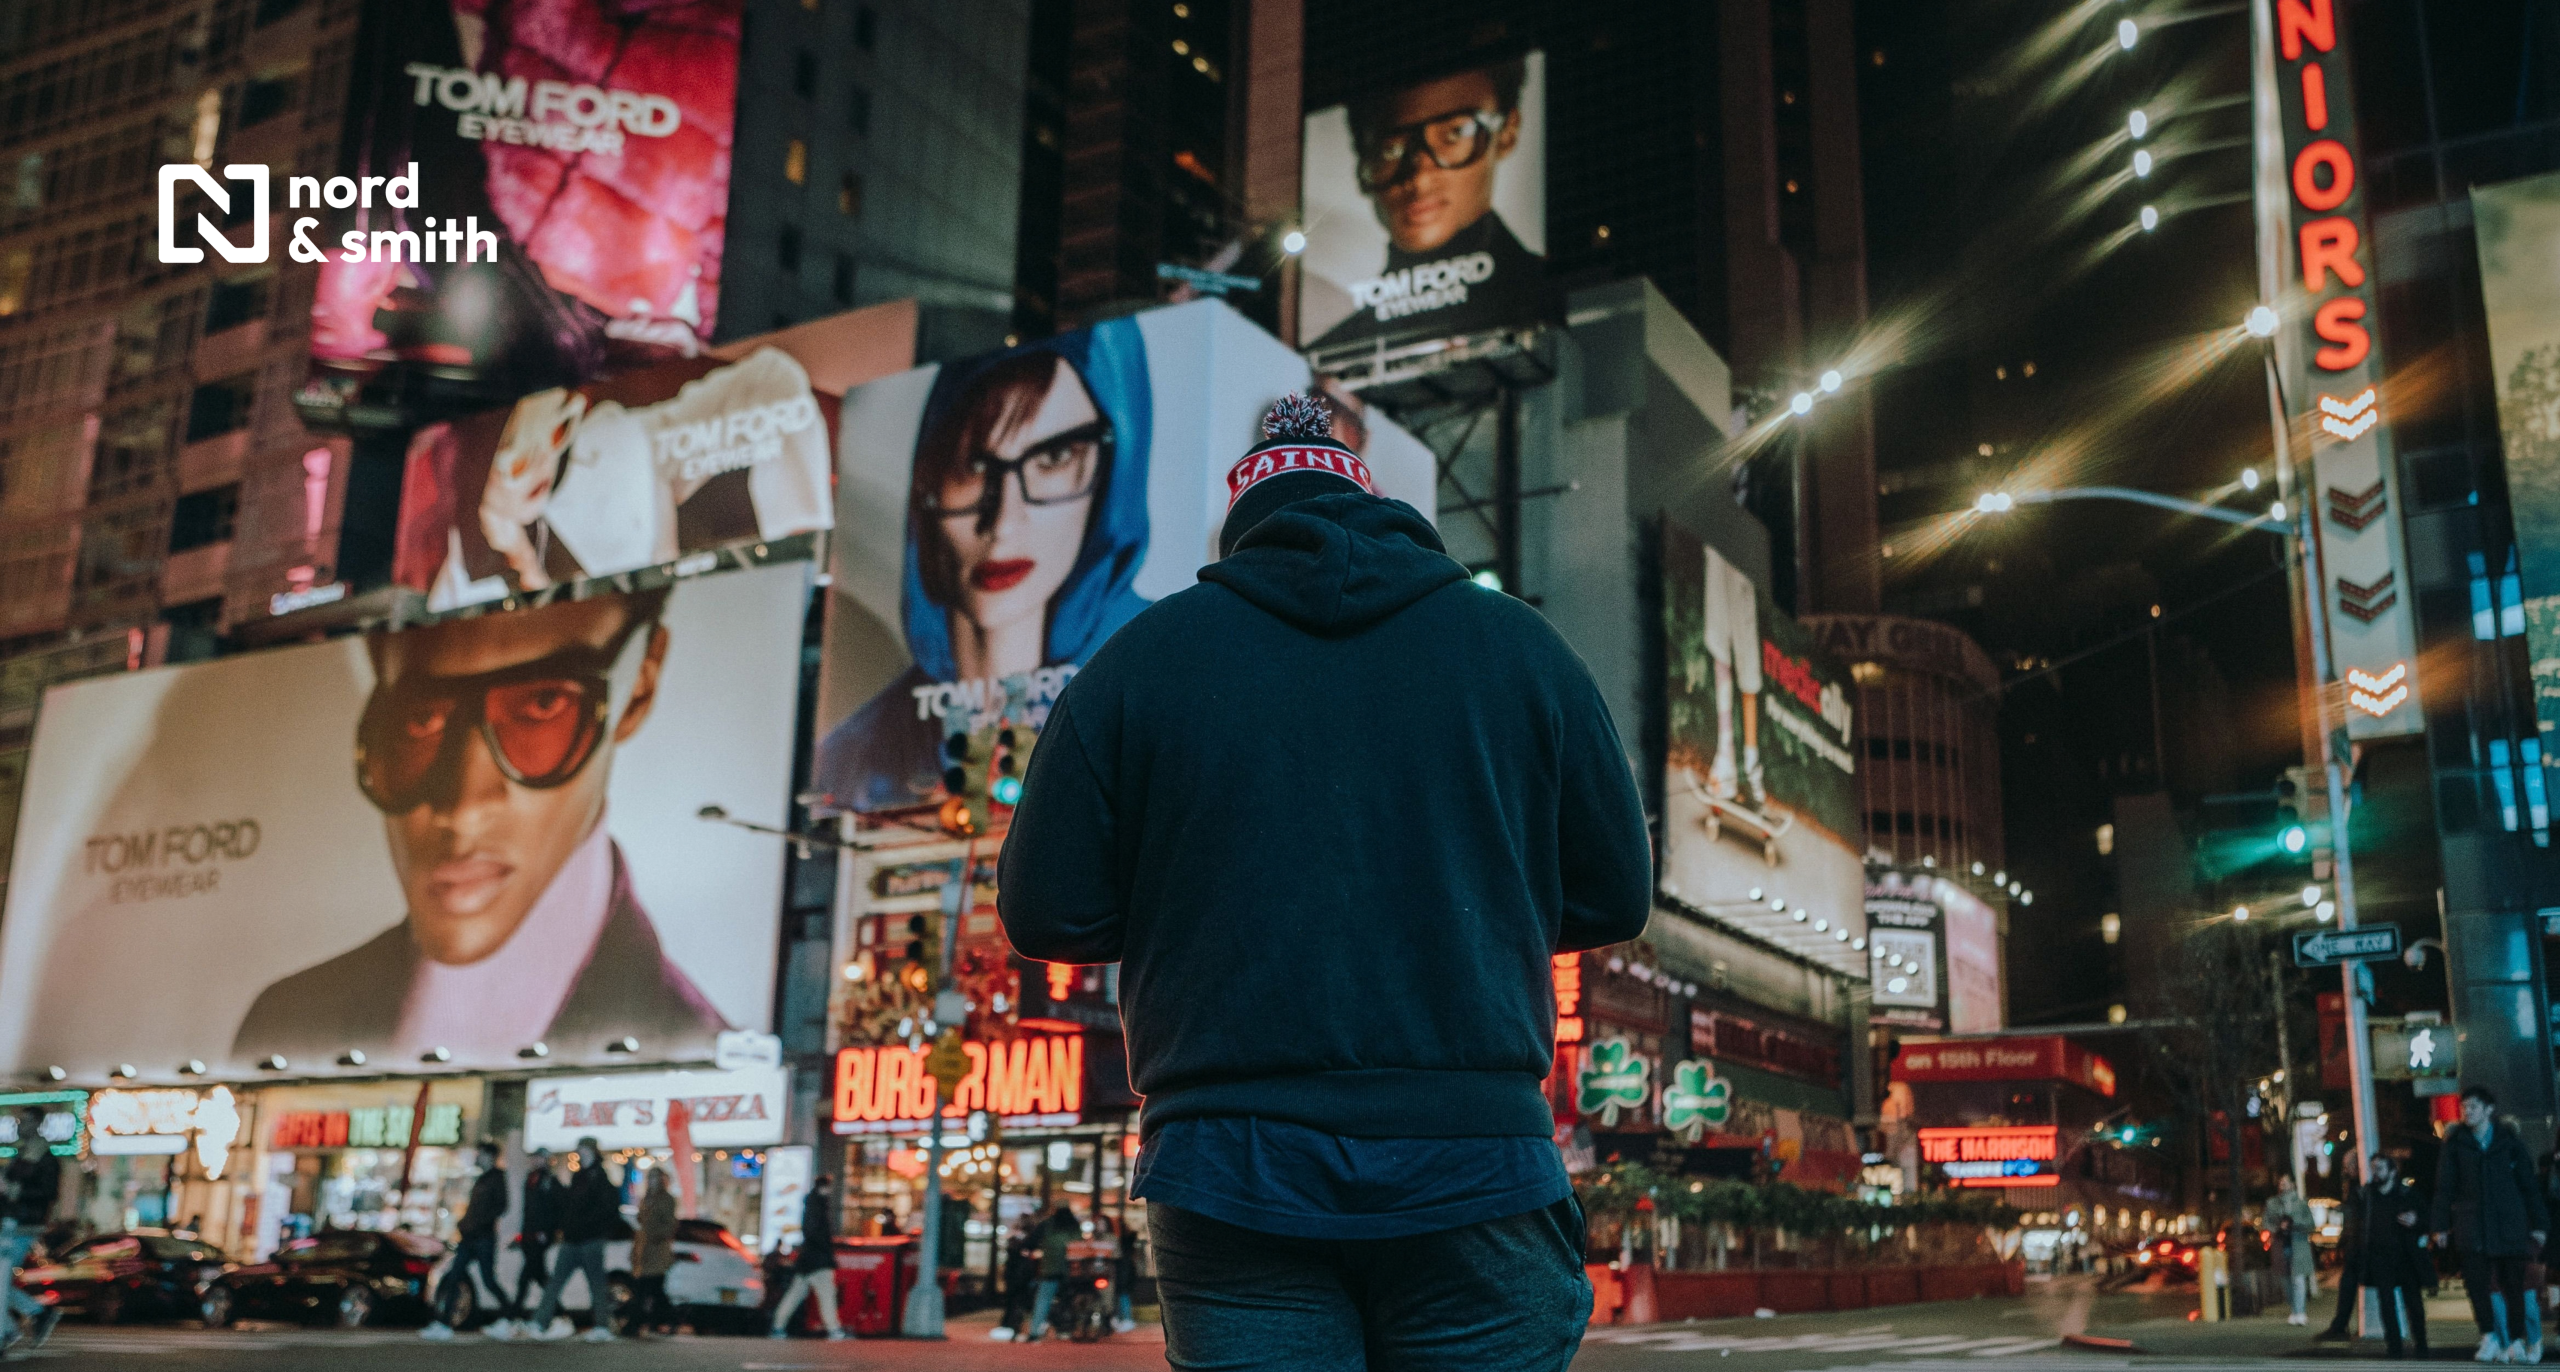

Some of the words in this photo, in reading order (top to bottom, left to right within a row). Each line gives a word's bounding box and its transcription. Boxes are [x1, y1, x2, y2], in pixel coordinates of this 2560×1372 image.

[405, 61, 530, 120] TOM
[531, 79, 681, 138] FORD
[456, 112, 626, 157] EYEWEAR
[1349, 268, 1411, 311] TOM
[1412, 251, 1495, 298] FORD
[655, 417, 723, 465] TOM
[725, 395, 817, 448] FORD
[84, 829, 155, 876] TOM
[158, 816, 261, 867] FORD
[2310, 941, 2339, 957] ONE
[2354, 934, 2384, 952] WAY
[832, 1040, 986, 1122] BURGR
[986, 1034, 1084, 1115] MAN
[561, 1099, 654, 1127] RAY'S
[1920, 1136, 1960, 1163] THE
